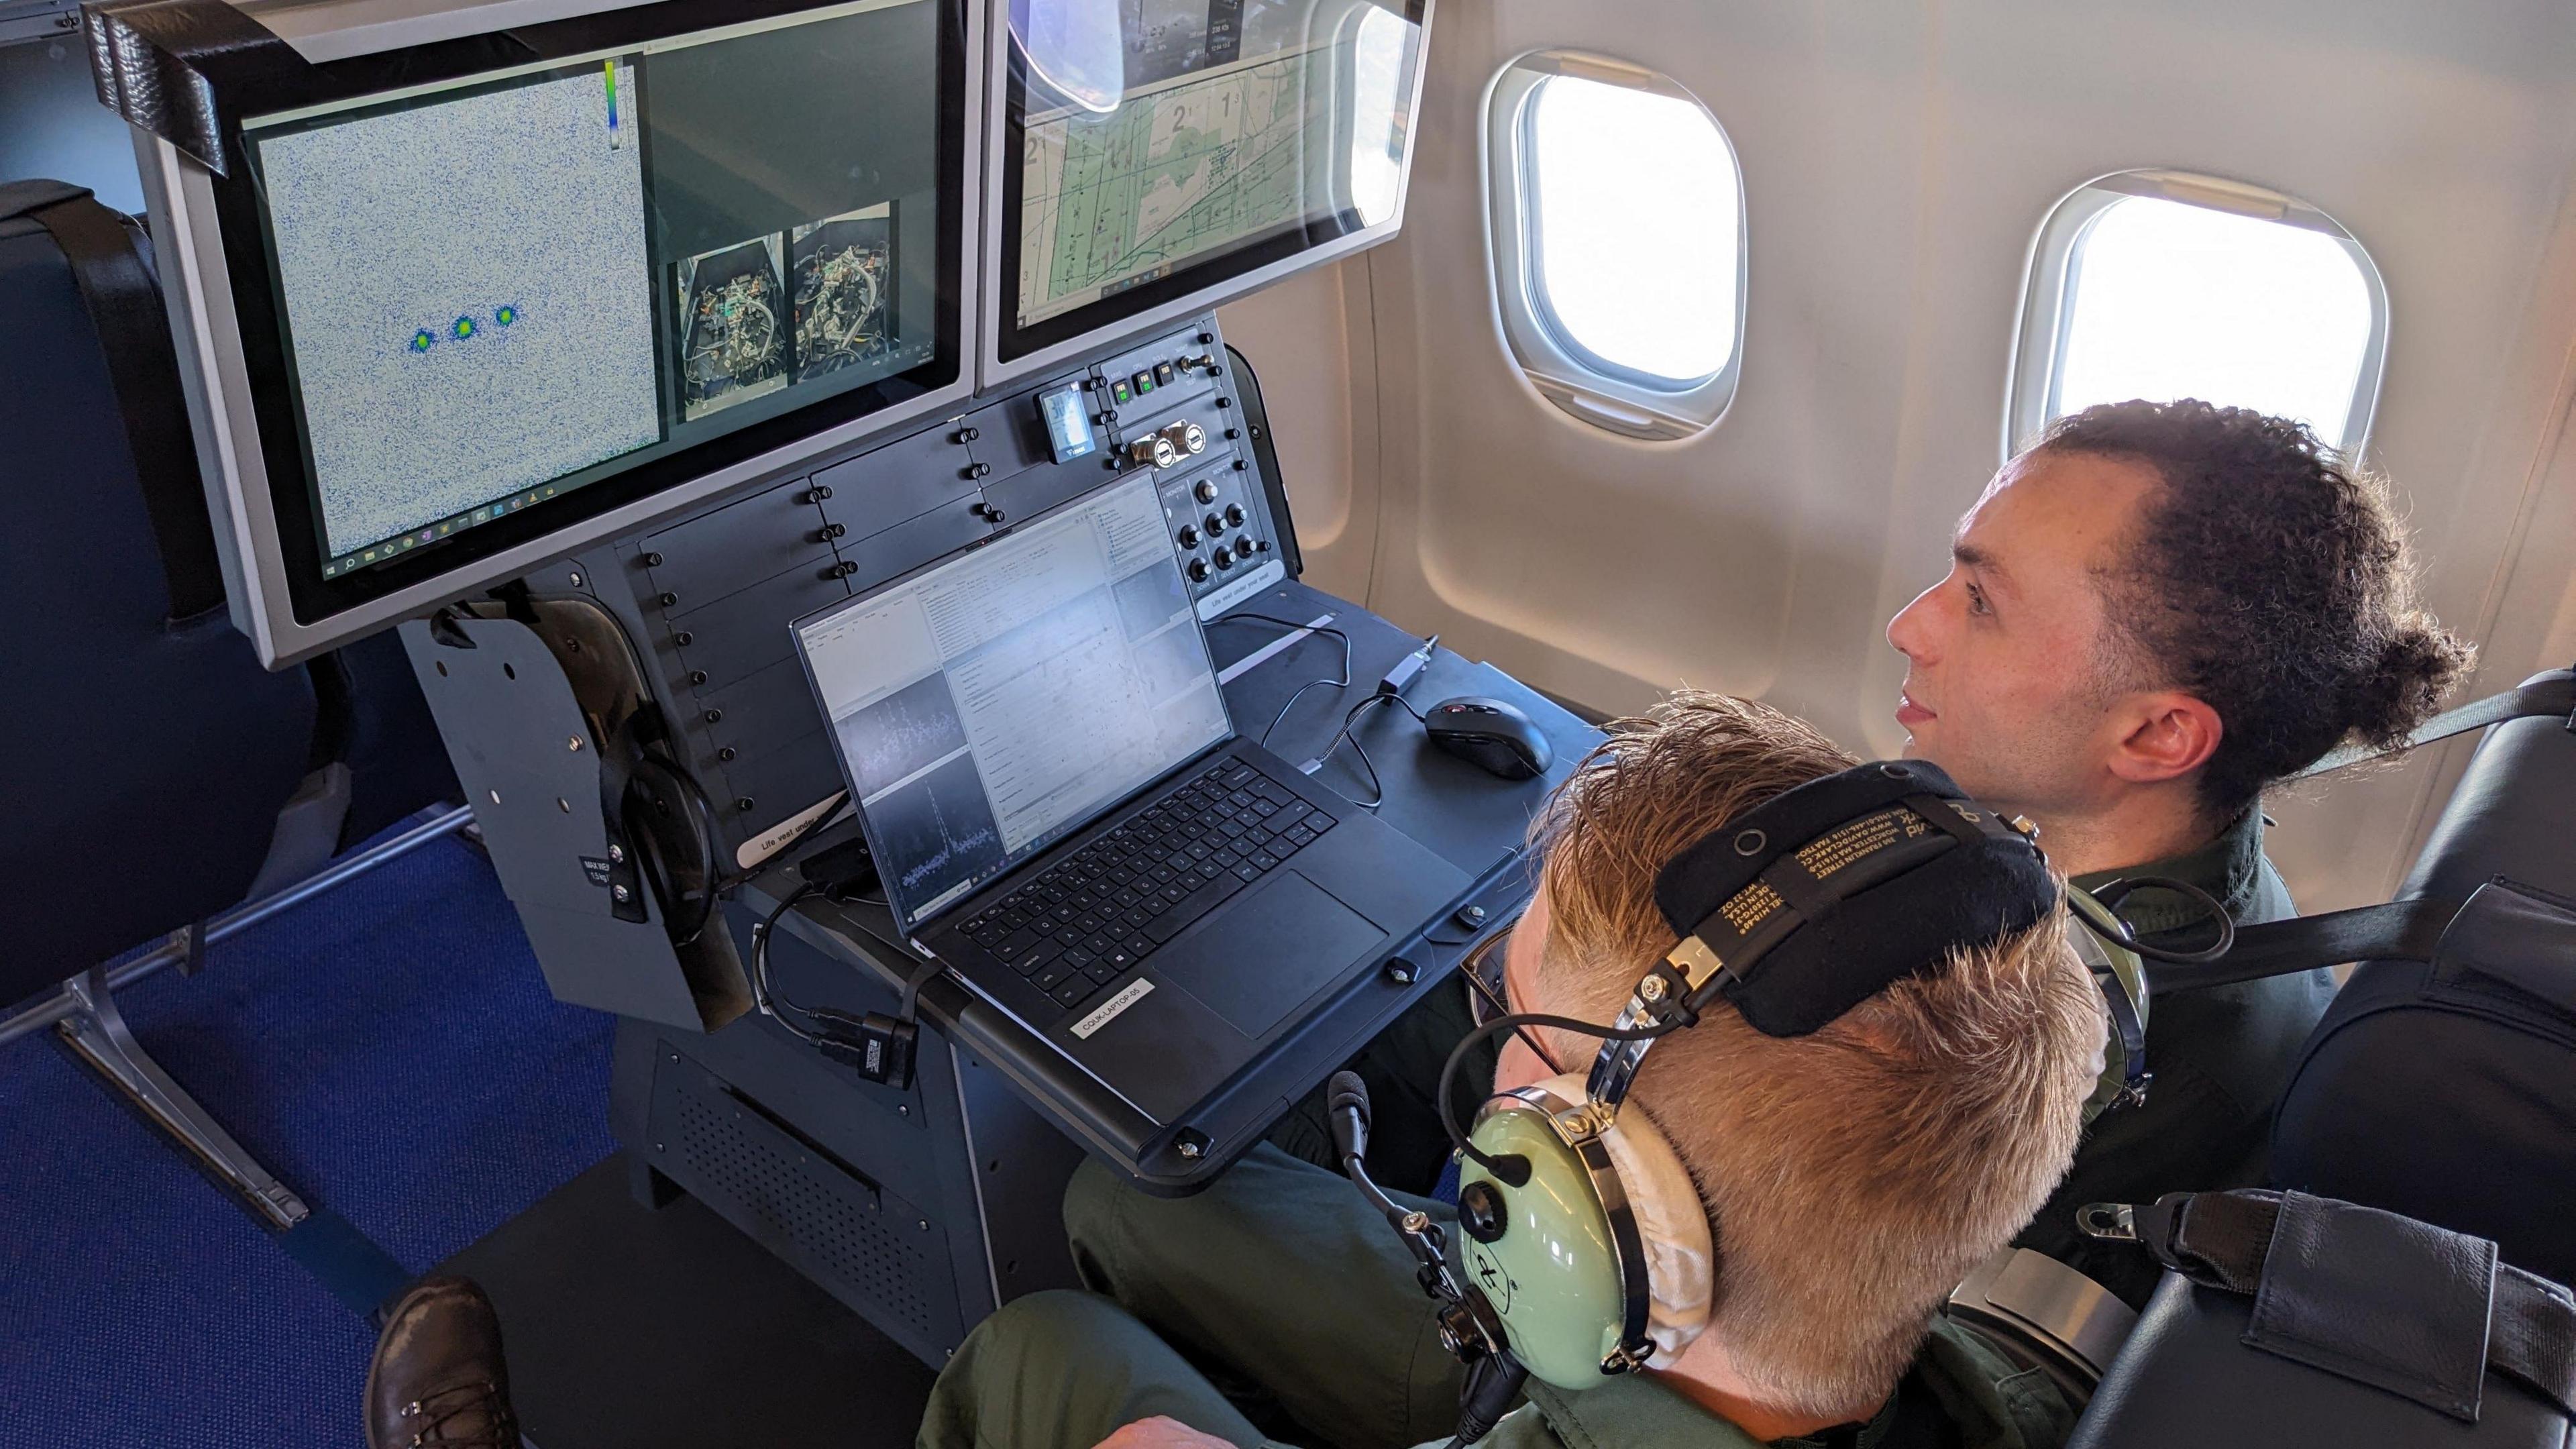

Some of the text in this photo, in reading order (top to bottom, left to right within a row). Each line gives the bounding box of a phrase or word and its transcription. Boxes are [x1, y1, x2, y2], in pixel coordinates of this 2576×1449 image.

[1173, 105, 1185, 133] 2
[1166, 484, 1185, 497] MONITOR
[1220, 568, 1236, 580] SELECT
[1212, 572, 1269, 607] Life vest under your seat
[761, 839, 775, 851] Life
[777, 828, 793, 842] vest
[795, 818, 816, 833] under
[1838, 846, 1852, 856] MA
[1845, 842, 1882, 863] FRANKLIN
[1809, 853, 1839, 873] 01615-0
[1817, 859, 1845, 879] STREET
[1717, 883, 1758, 914] WT. 22 OZ.
[1746, 894, 1758, 904] IN
[1724, 902, 1748, 920] U.S.A.
[1083, 987, 1140, 1031] CQUK-LAPTOP-05
